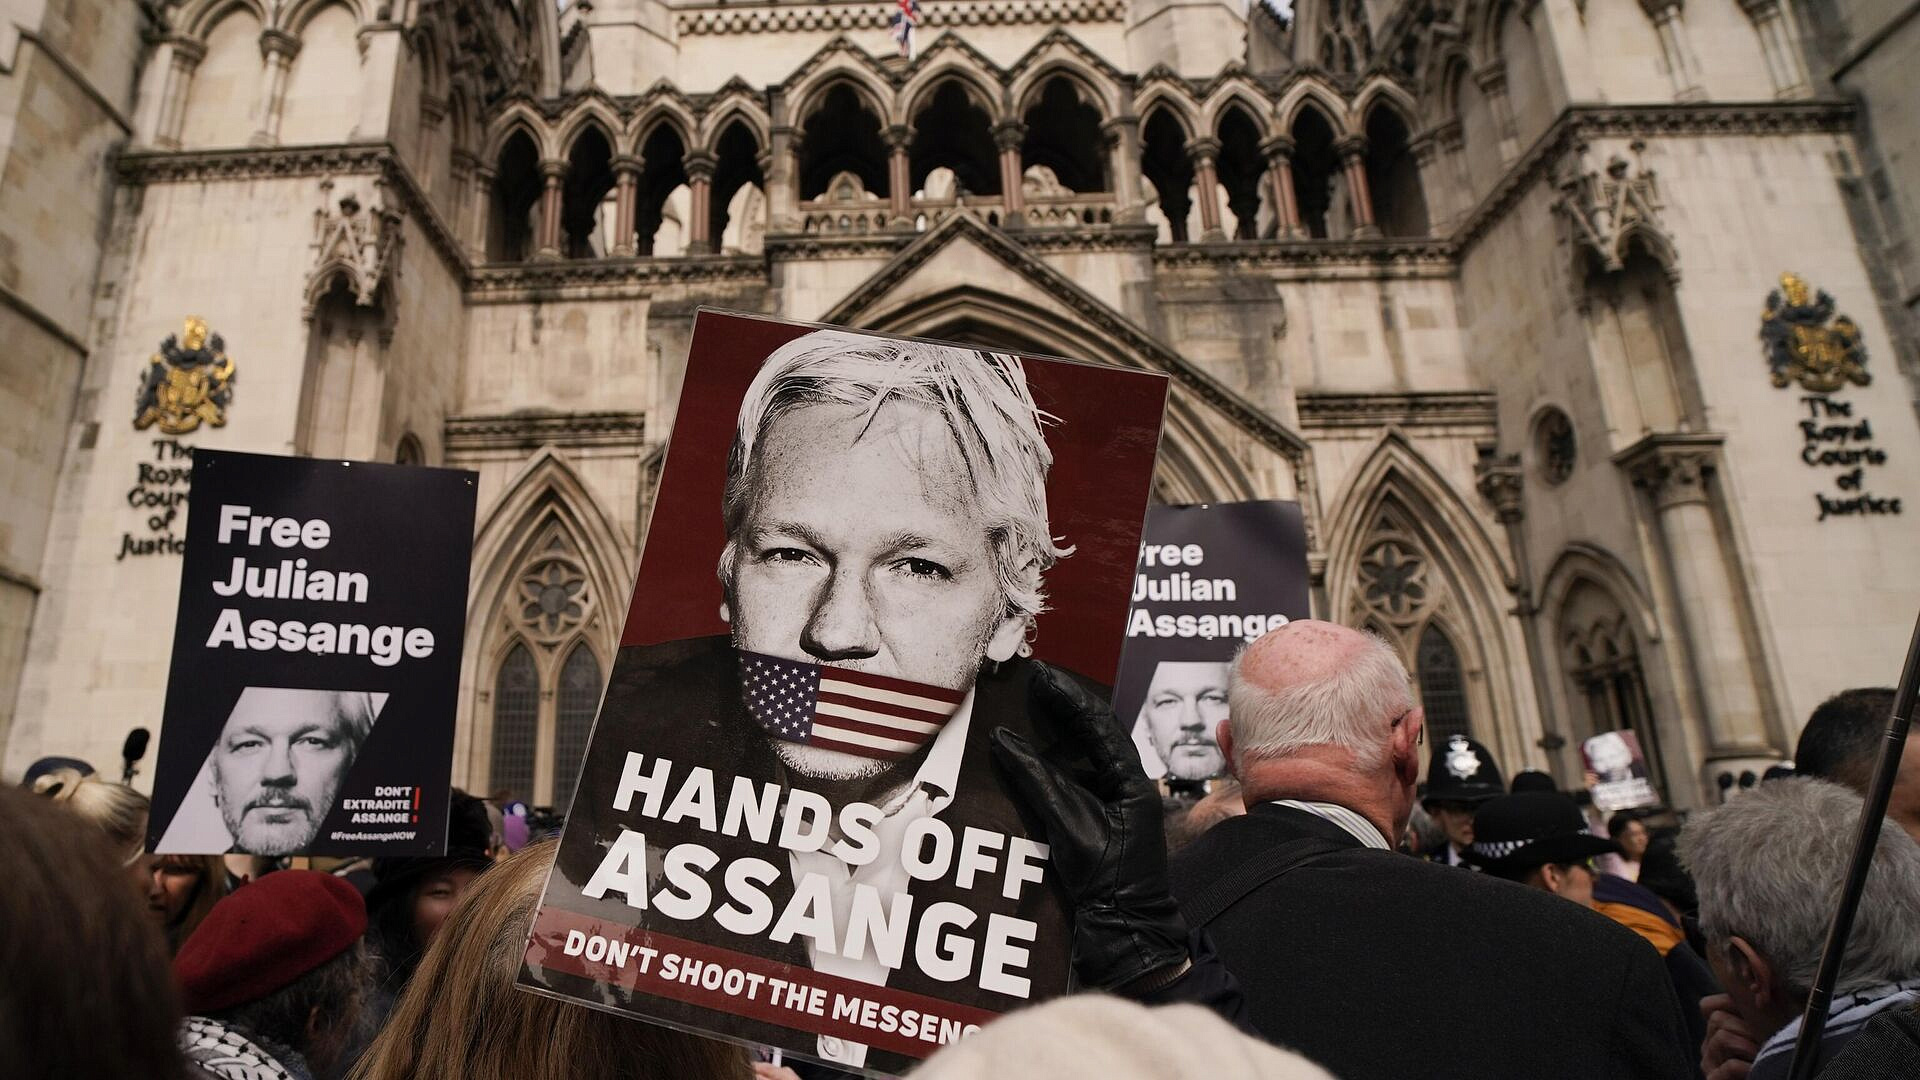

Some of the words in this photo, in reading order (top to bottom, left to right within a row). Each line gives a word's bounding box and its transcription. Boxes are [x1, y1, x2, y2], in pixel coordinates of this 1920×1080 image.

[1799, 397, 1852, 417] The
[1799, 420, 1872, 445] Royal
[1802, 446, 1887, 466] Courts
[138, 463, 191, 486] Roya
[1836, 468, 1862, 490] of
[127, 487, 188, 508] Cour
[1815, 493, 1902, 521] Justice
[148, 509, 176, 531] of
[217, 504, 331, 549] Free
[117, 533, 185, 562] Justic
[1139, 541, 1204, 567] ree
[212, 557, 369, 603] Julian
[1133, 572, 1236, 602] Julian
[205, 608, 435, 666] Assange
[375, 786, 412, 797] DON'T
[343, 799, 411, 810] EXTRADITE
[351, 812, 409, 824] ASSANGE
[613, 751, 886, 866] HANDS
[901, 817, 1050, 900] OFF
[330, 831, 417, 842] #FreeAssangeNOW
[581, 830, 1038, 999] ASSANGE
[563, 929, 659, 974] DON'T
[658, 953, 766, 1000] SHOOT
[767, 978, 828, 1017] THE
